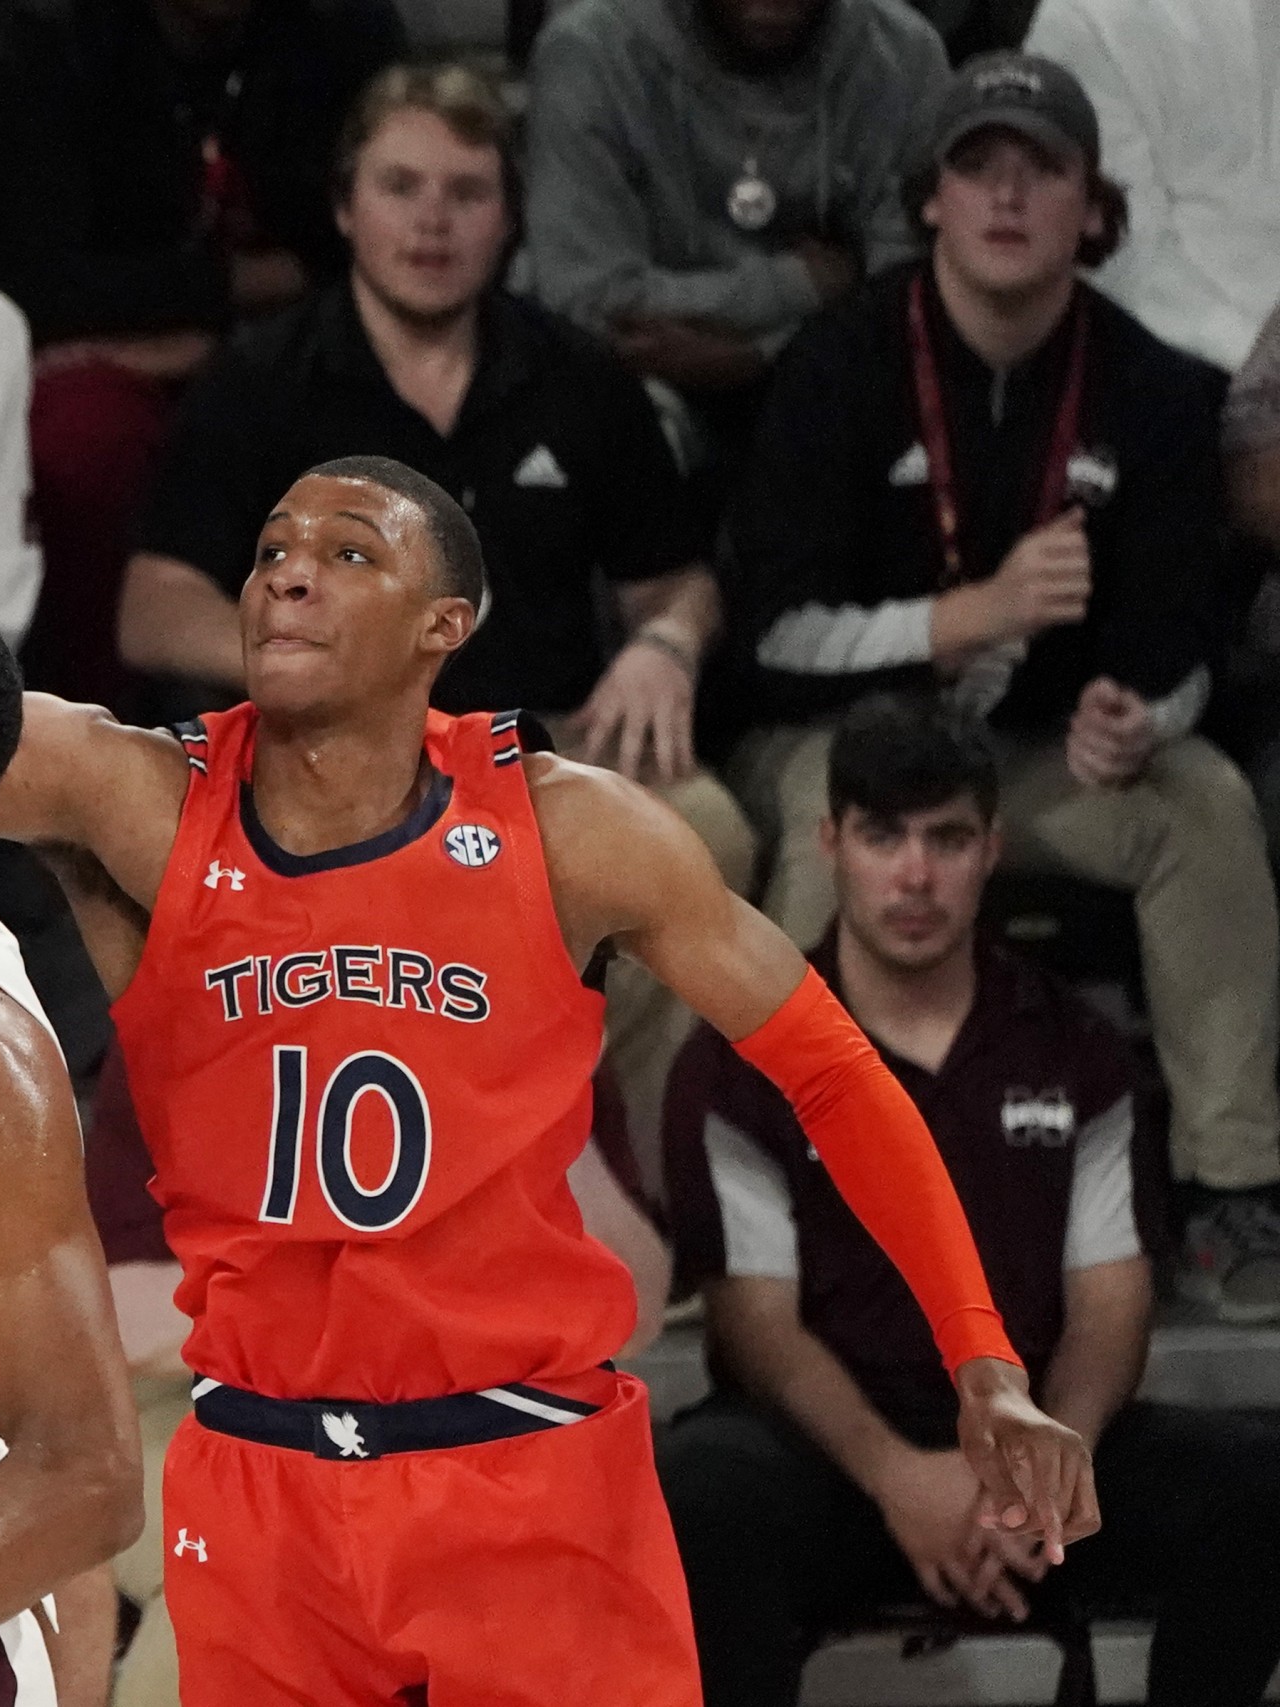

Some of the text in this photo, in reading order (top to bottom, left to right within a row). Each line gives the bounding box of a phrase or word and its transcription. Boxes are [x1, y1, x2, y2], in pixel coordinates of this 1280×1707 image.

[444, 824, 501, 868] SEC
[206, 944, 490, 1024] TIGERS
[258, 1044, 432, 1233] 10
